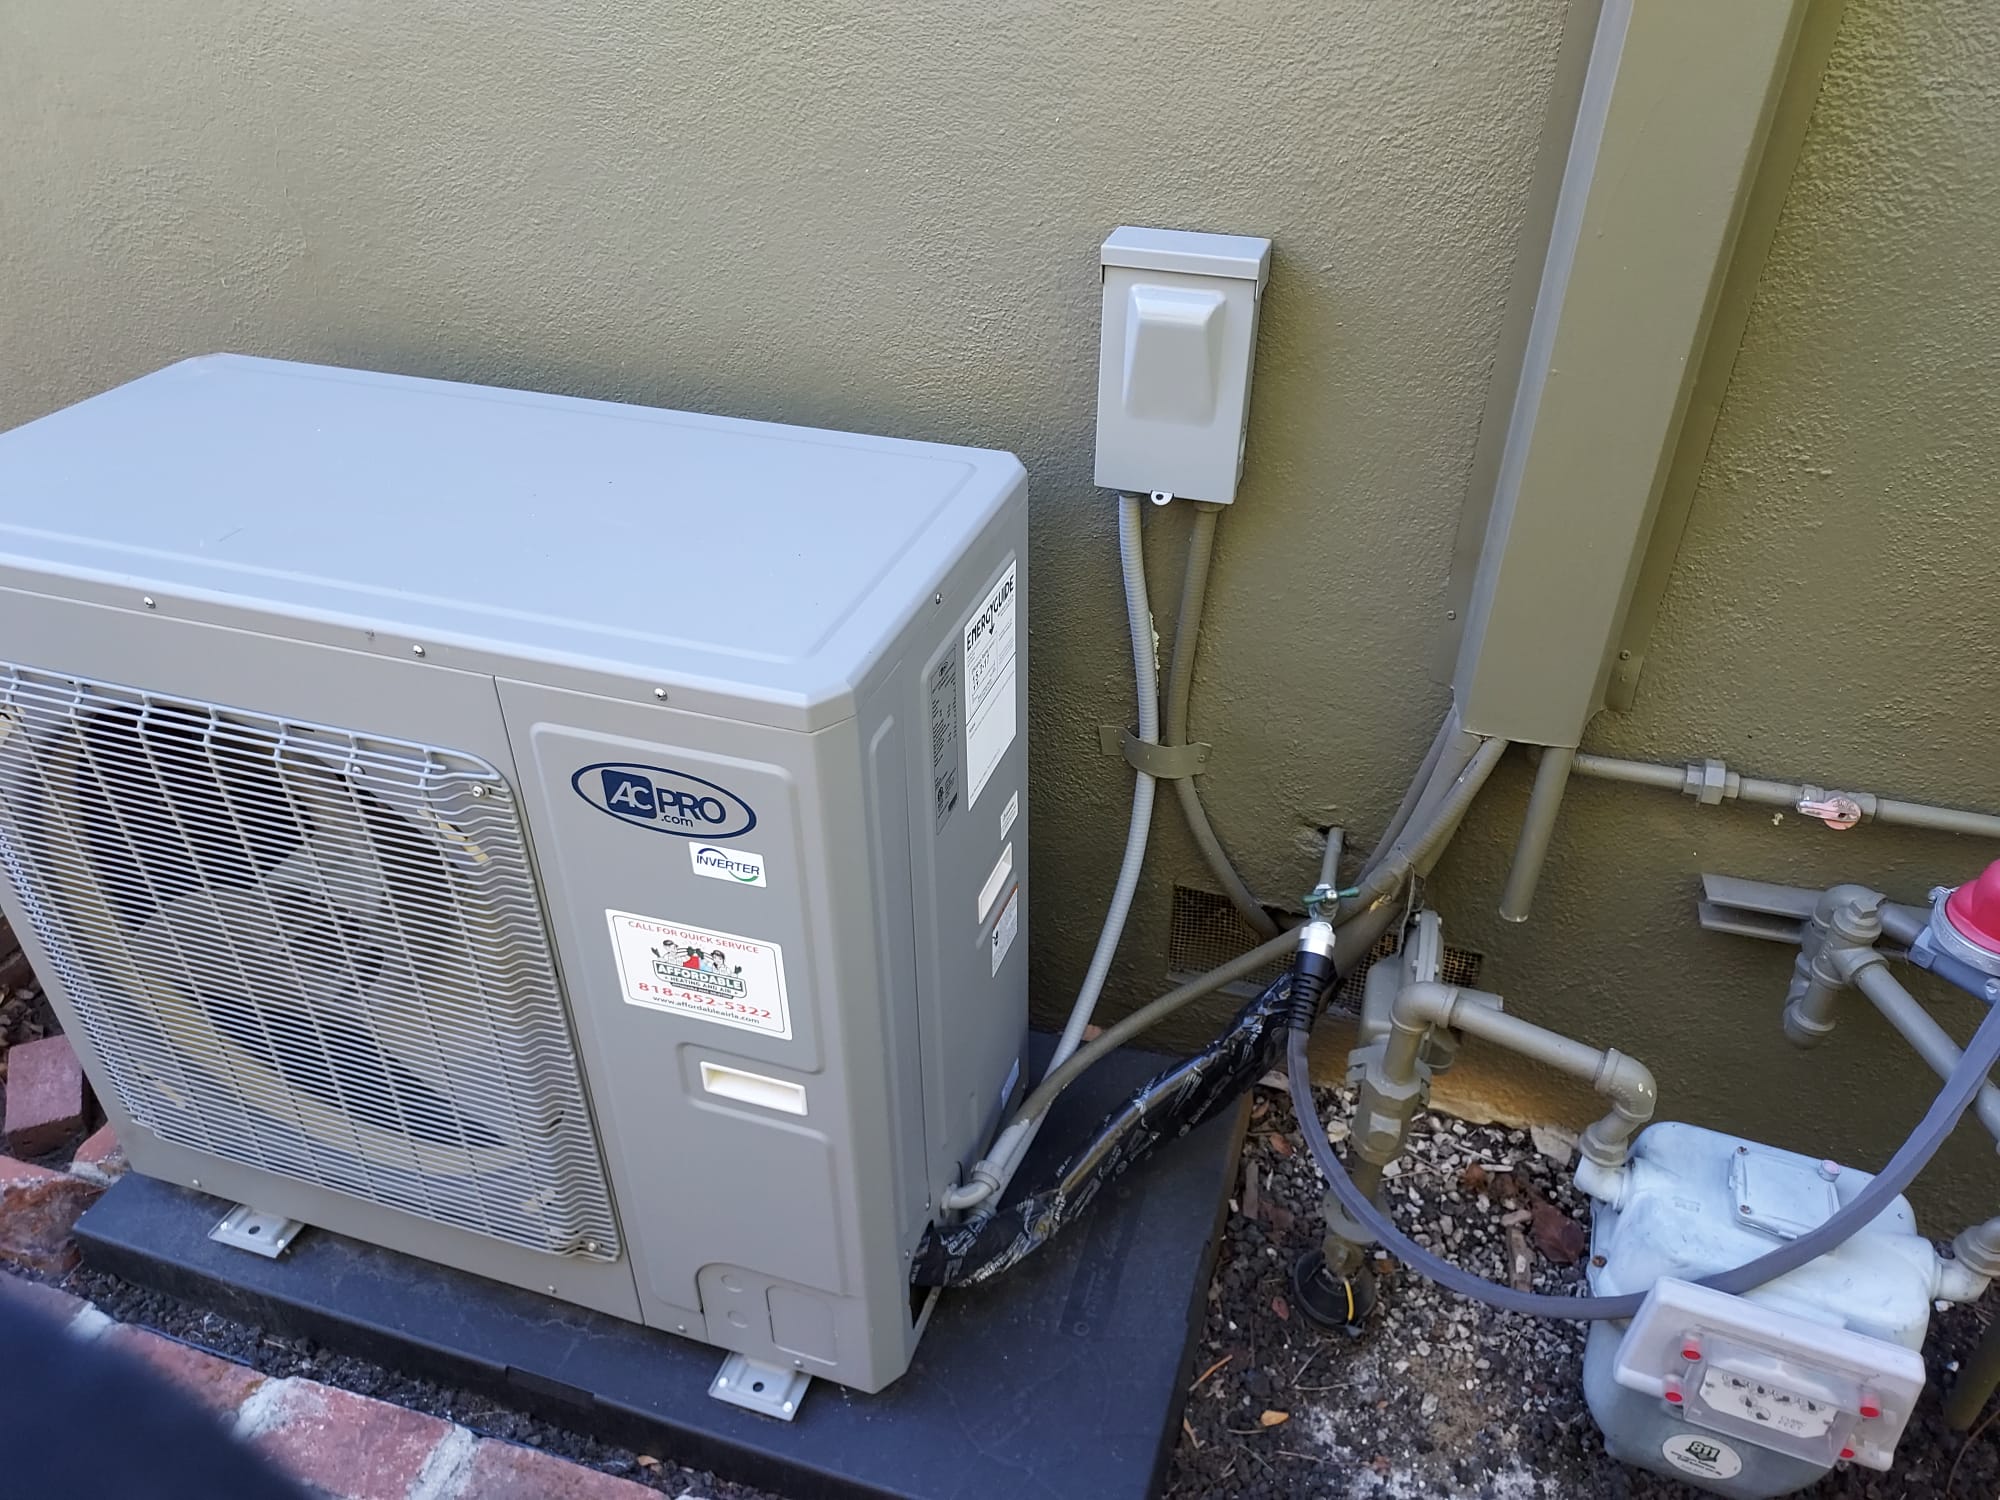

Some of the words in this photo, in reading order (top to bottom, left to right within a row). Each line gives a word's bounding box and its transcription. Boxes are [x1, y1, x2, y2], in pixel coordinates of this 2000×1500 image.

[661, 815, 694, 828] .com
[696, 855, 760, 875] INVERTER
[628, 920, 655, 932] CALL
[656, 926, 678, 937] FOR
[680, 931, 713, 944] QUICK
[715, 938, 759, 954] SERVICE
[657, 963, 742, 990] AFFORDABLE
[671, 976, 702, 987] HEATING
[638, 982, 773, 1020] 818-452-5322
[1690, 1441, 1720, 1458] 811
